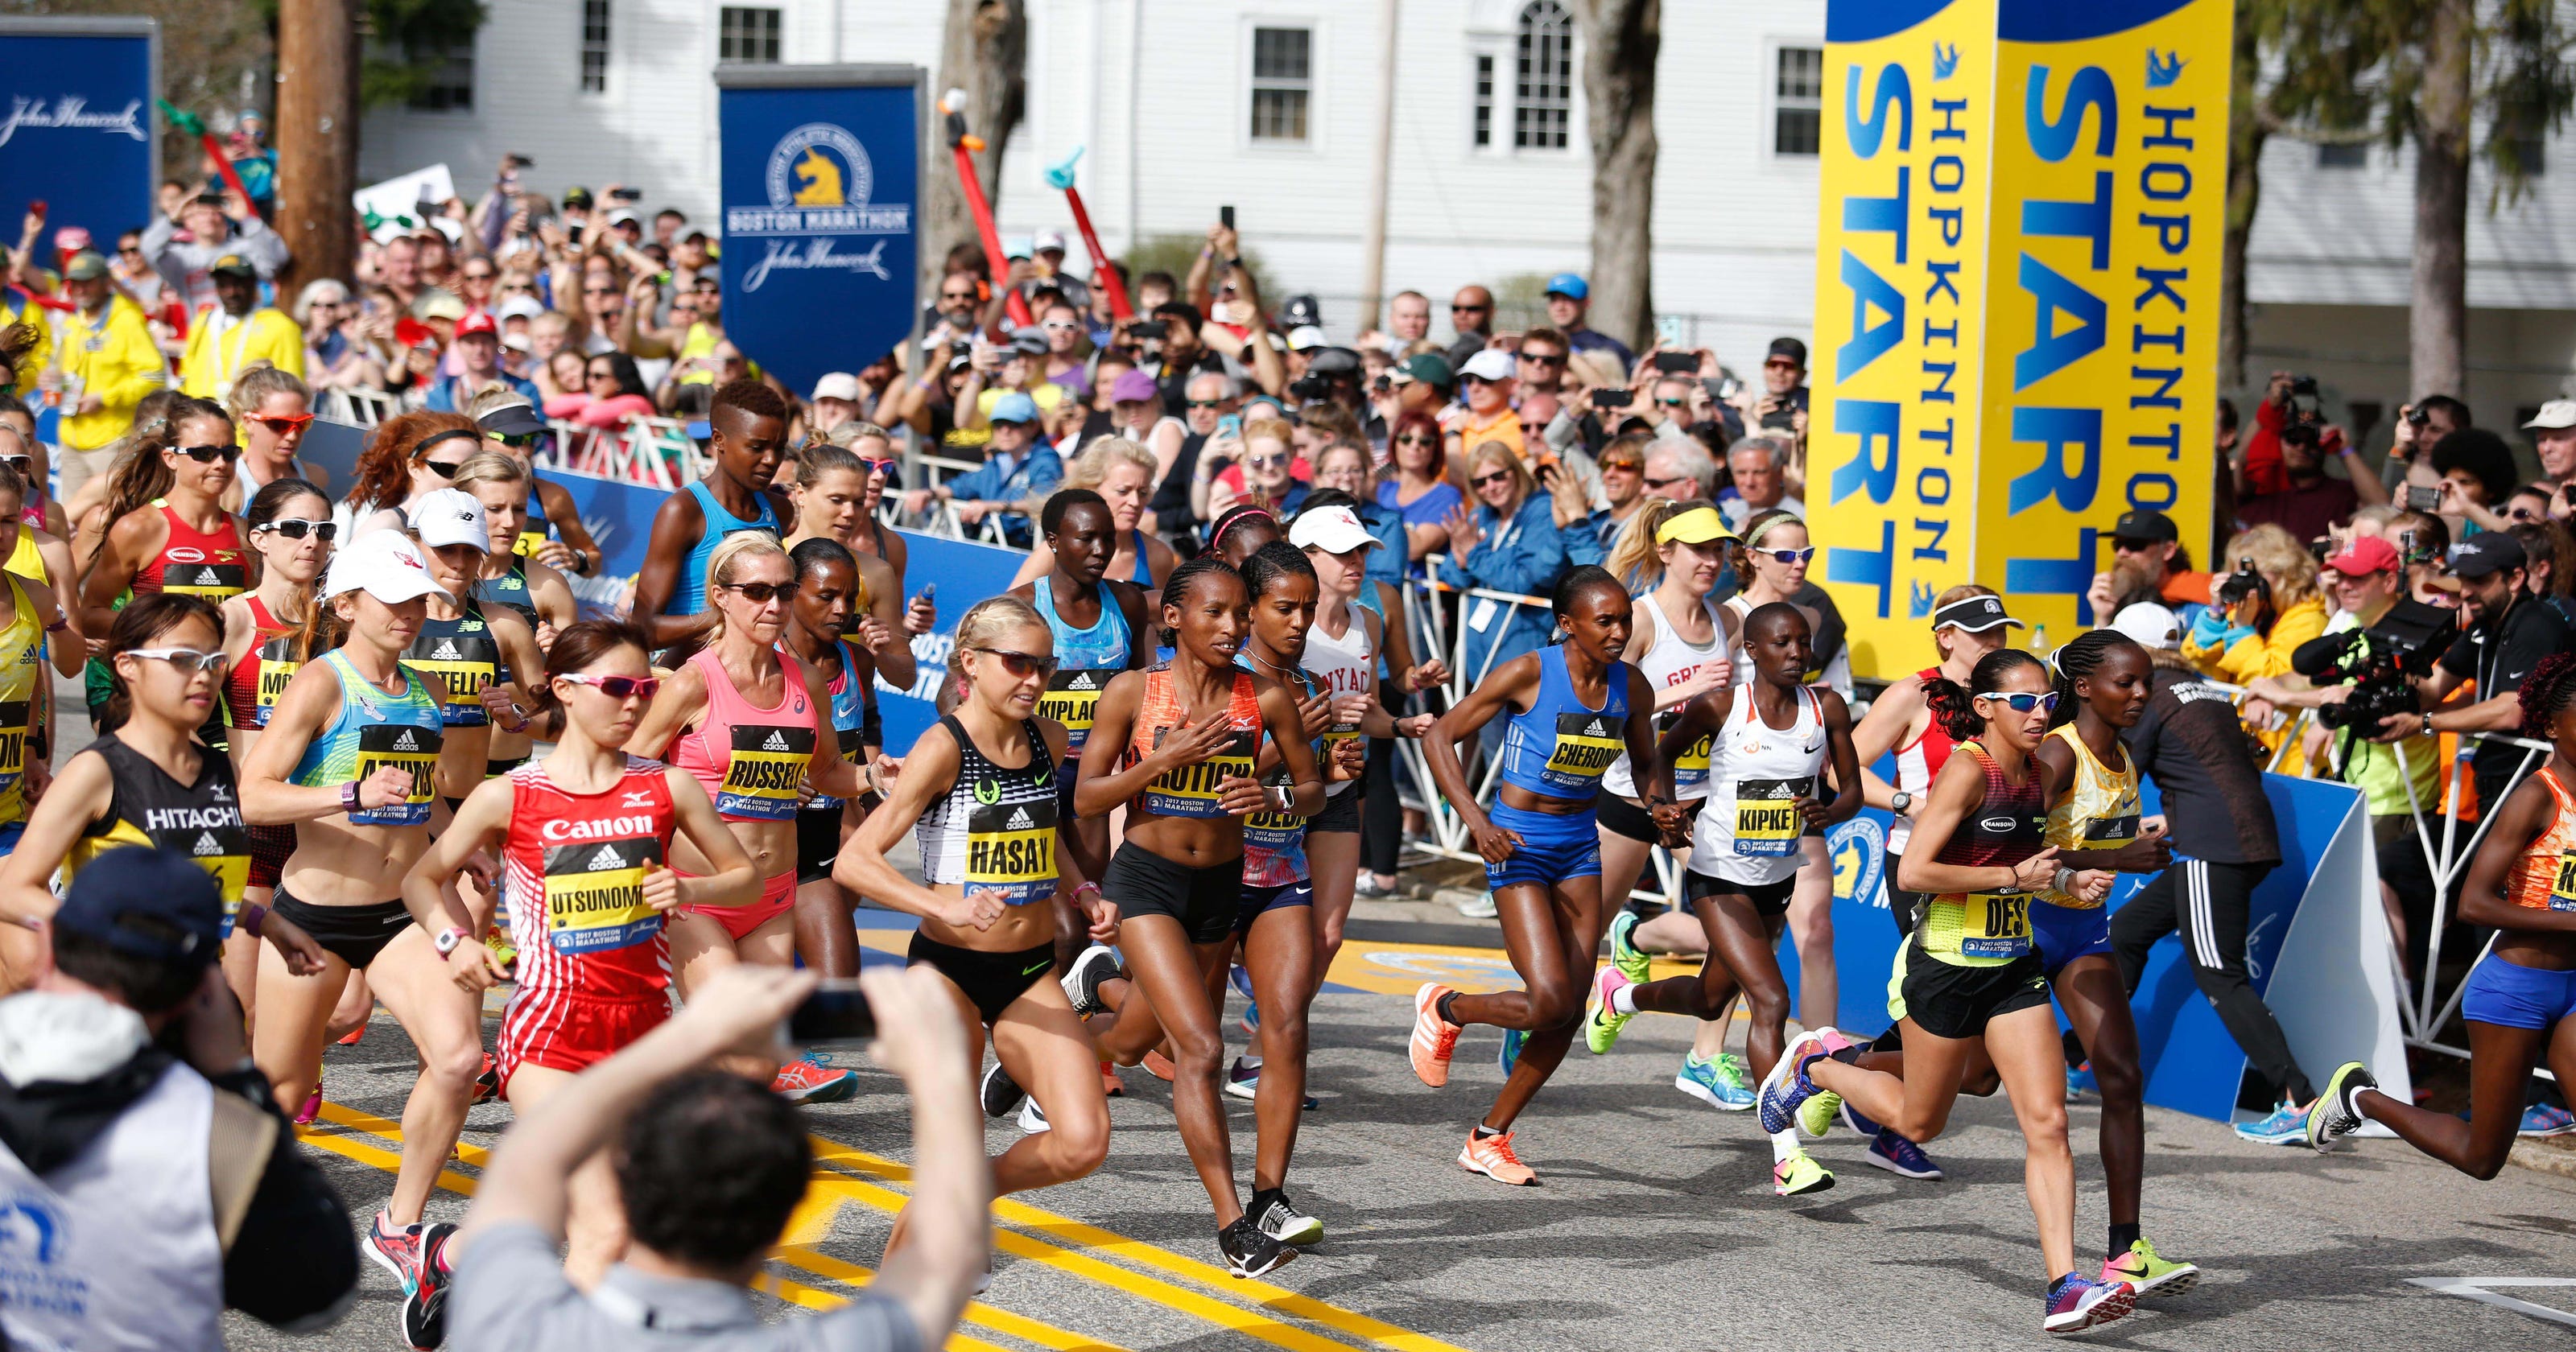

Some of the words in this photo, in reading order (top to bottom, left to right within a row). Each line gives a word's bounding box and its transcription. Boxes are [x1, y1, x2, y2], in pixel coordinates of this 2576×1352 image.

[727, 210, 802, 233] BOSTON
[805, 209, 908, 231] MARATHON
[2125, 105, 2195, 513] HOPKINTO
[1912, 97, 1967, 563] HOPKINTON
[1827, 61, 1913, 620] START
[2004, 63, 2118, 628] START
[20, 656, 38, 665] adida
[431, 652, 463, 660] adidas
[427, 670, 493, 696] TELLO
[1067, 682, 1097, 690] adidas
[1583, 728, 1607, 737] adidas
[393, 743, 419, 751] adidas
[762, 742, 790, 752] adidas
[360, 759, 436, 797] ANS
[727, 760, 806, 790] RUSSELL
[1165, 797, 1179, 805] 2017
[736, 802, 771, 813] MARATHON
[1164, 803, 1204, 812] MARATHON
[146, 806, 242, 831] HITACHI
[1738, 808, 1800, 831] KIPKET
[542, 814, 654, 840] Canon
[1006, 820, 1035, 831] adidas
[2105, 831, 2124, 839] adidas
[193, 846, 225, 855] adidas
[969, 837, 1049, 876] HASAY
[588, 858, 627, 871] adidas
[2557, 861, 2576, 893] K
[1003, 884, 1028, 892] BOSTON
[1984, 896, 2025, 937] DES
[575, 932, 592, 940] 2017
[592, 929, 621, 938] BOSTON
[575, 935, 621, 947] MARATHON
